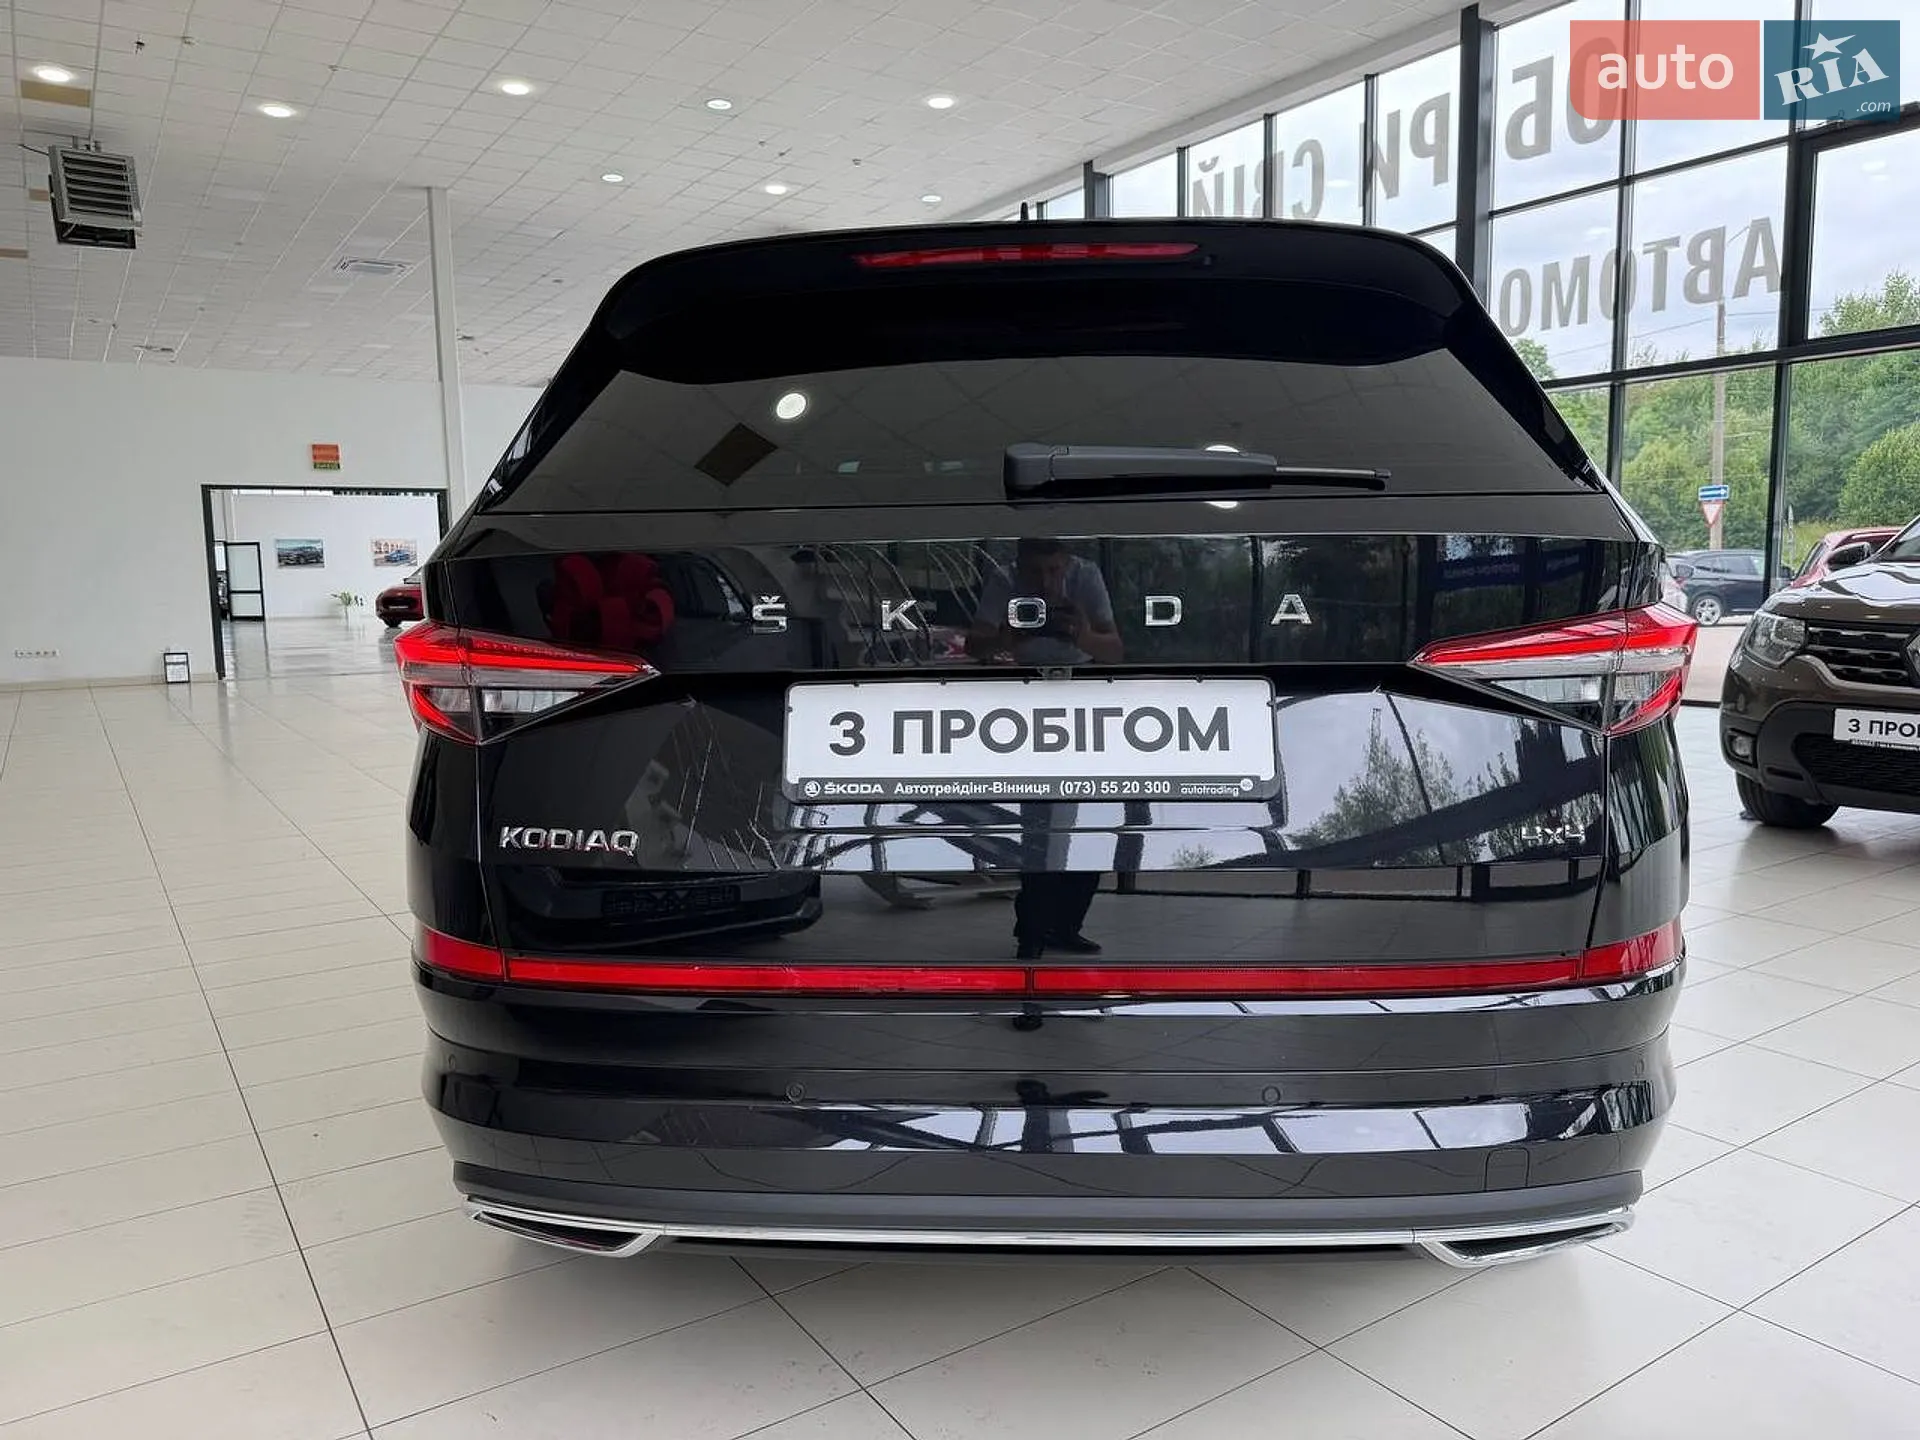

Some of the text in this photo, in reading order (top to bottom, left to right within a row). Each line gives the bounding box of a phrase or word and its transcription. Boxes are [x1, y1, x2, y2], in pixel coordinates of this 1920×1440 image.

[829, 705, 1230, 756] З ПРОБІГОМ
[1848, 718, 1920, 738] З ПРО
[824, 780, 1240, 797] ŠKODA Автотрейдінг-Вінниця (073) 55 20 300 autotrading
[499, 825, 639, 857] KODIAQ
